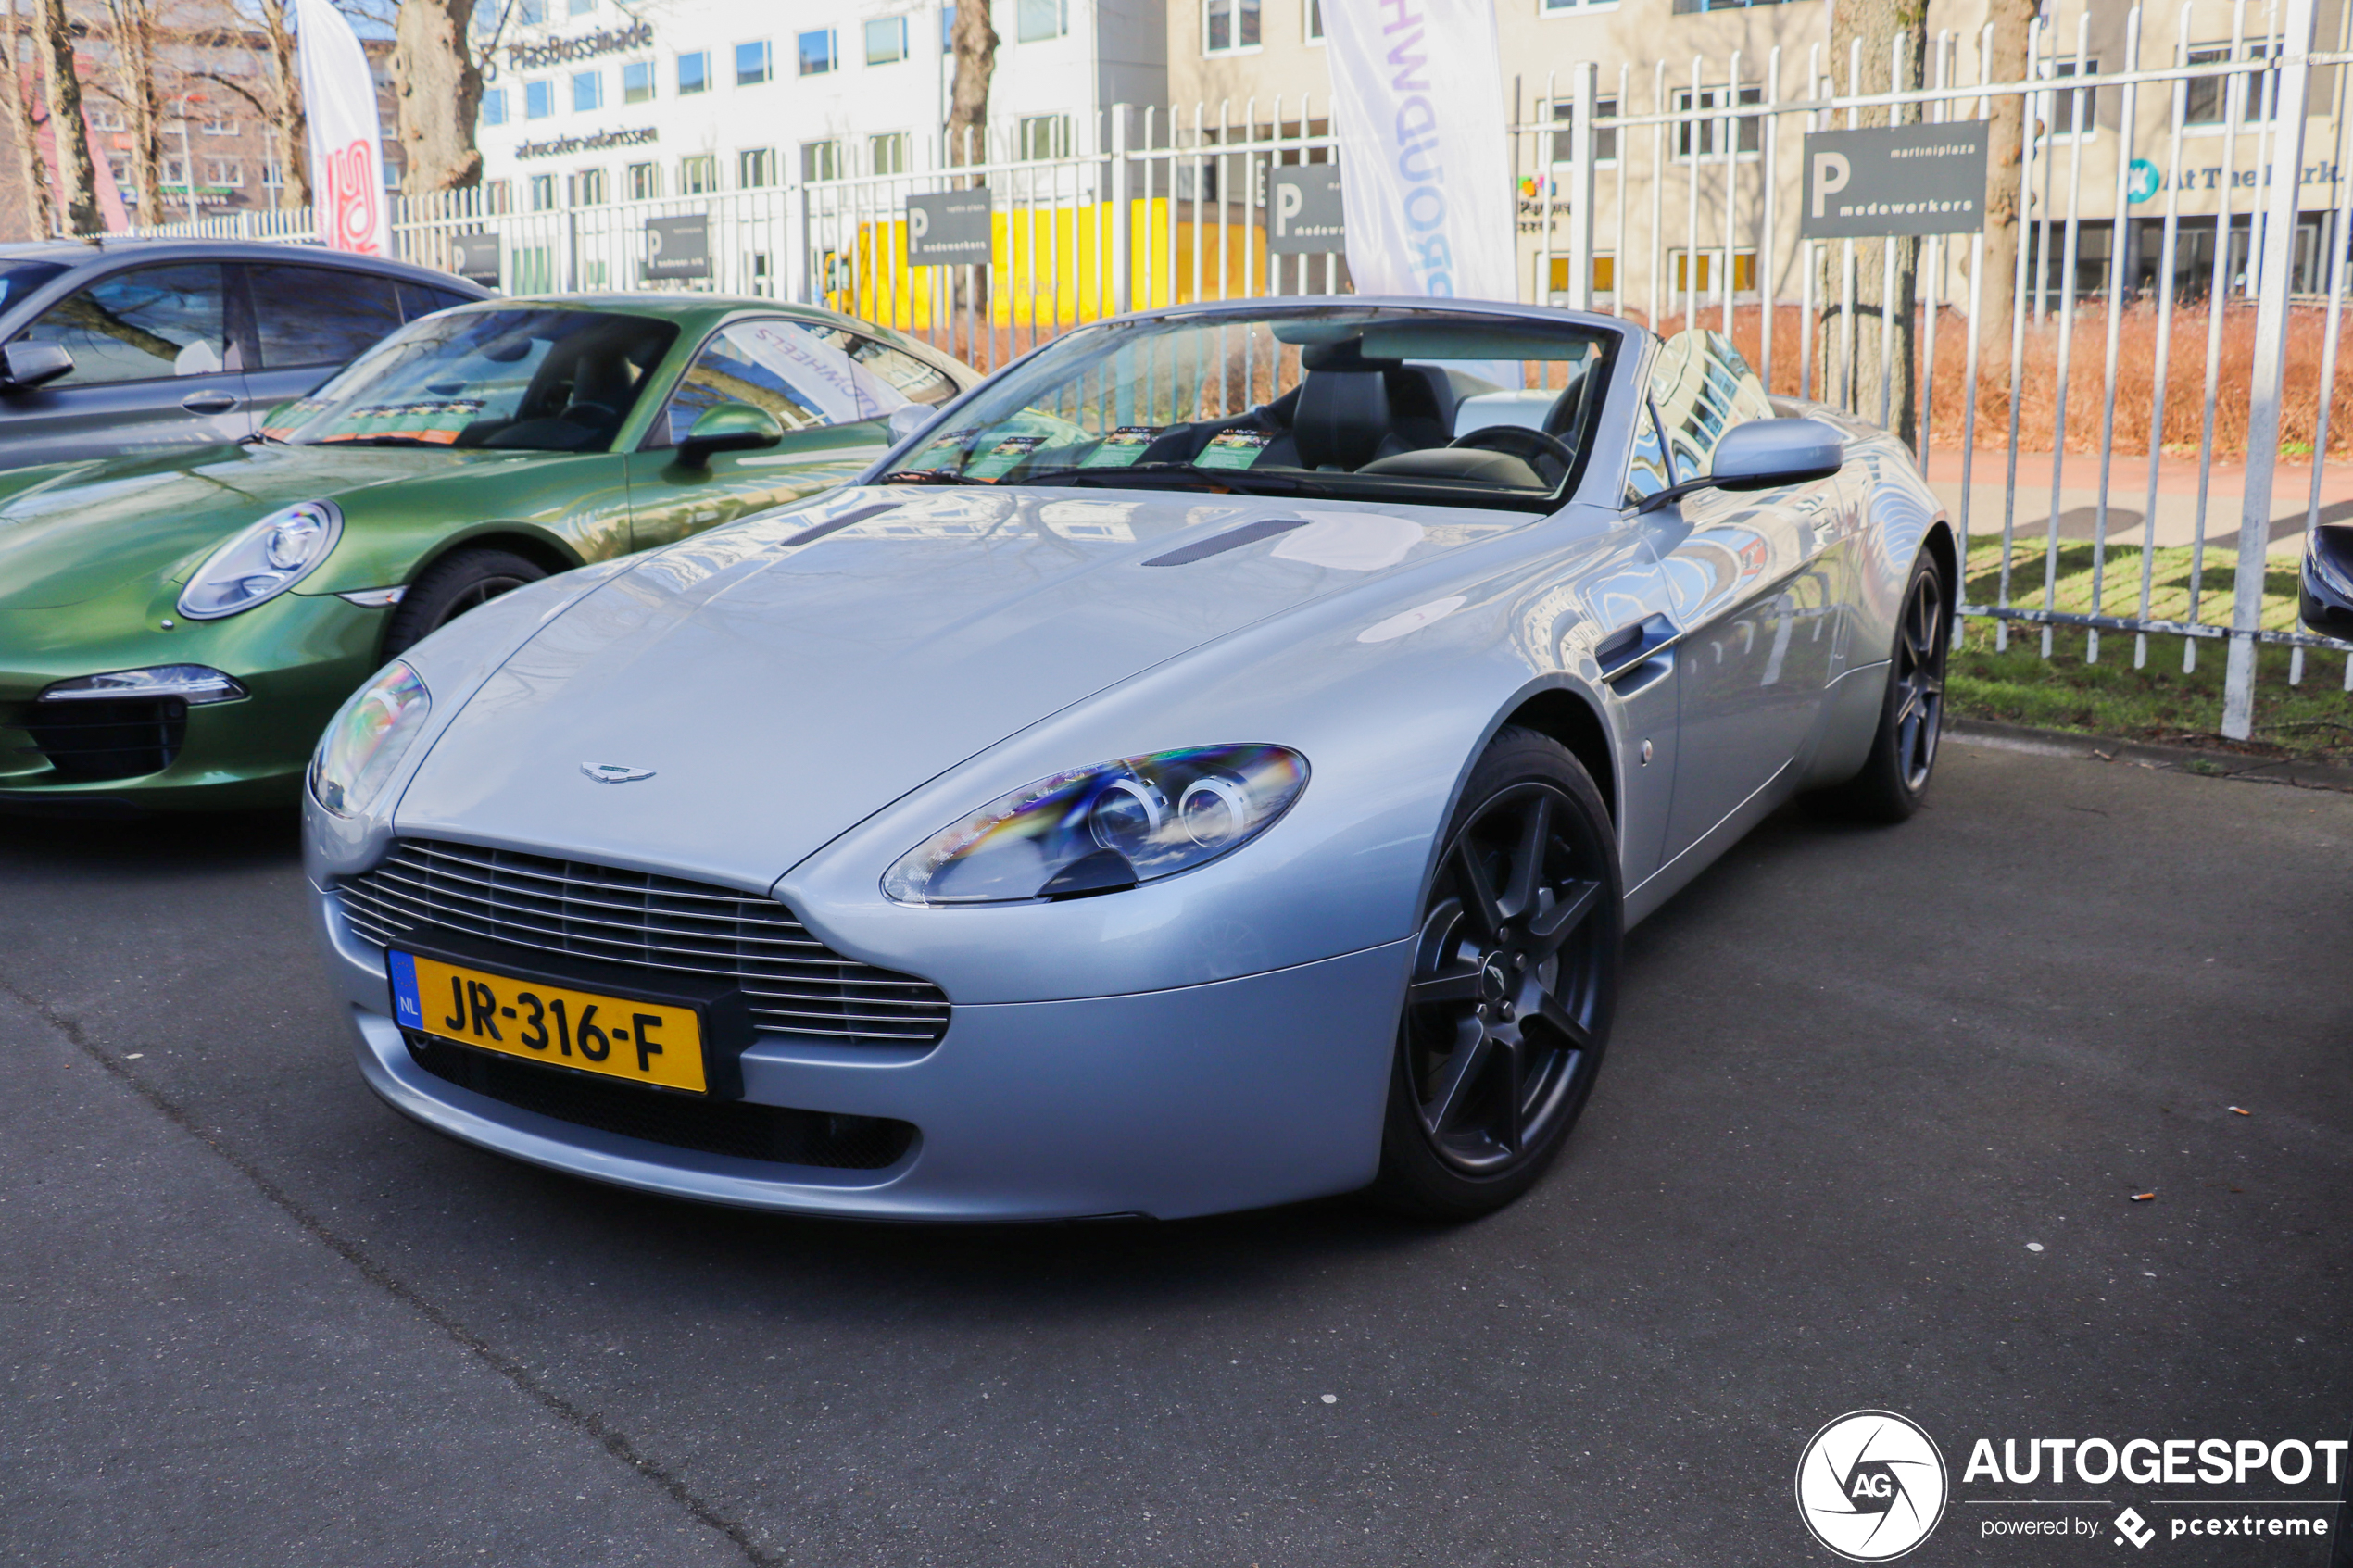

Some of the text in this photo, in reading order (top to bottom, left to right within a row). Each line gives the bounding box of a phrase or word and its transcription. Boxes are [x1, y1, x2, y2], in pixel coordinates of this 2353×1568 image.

[1890, 144, 1976, 158] martiniplaza
[1812, 152, 1851, 218] P
[1276, 182, 1303, 237] P
[1840, 199, 1973, 217] medewerkers
[647, 229, 663, 270] P
[909, 207, 929, 254] P
[399, 995, 419, 1016] NL
[445, 975, 663, 1072] JR-316-F
